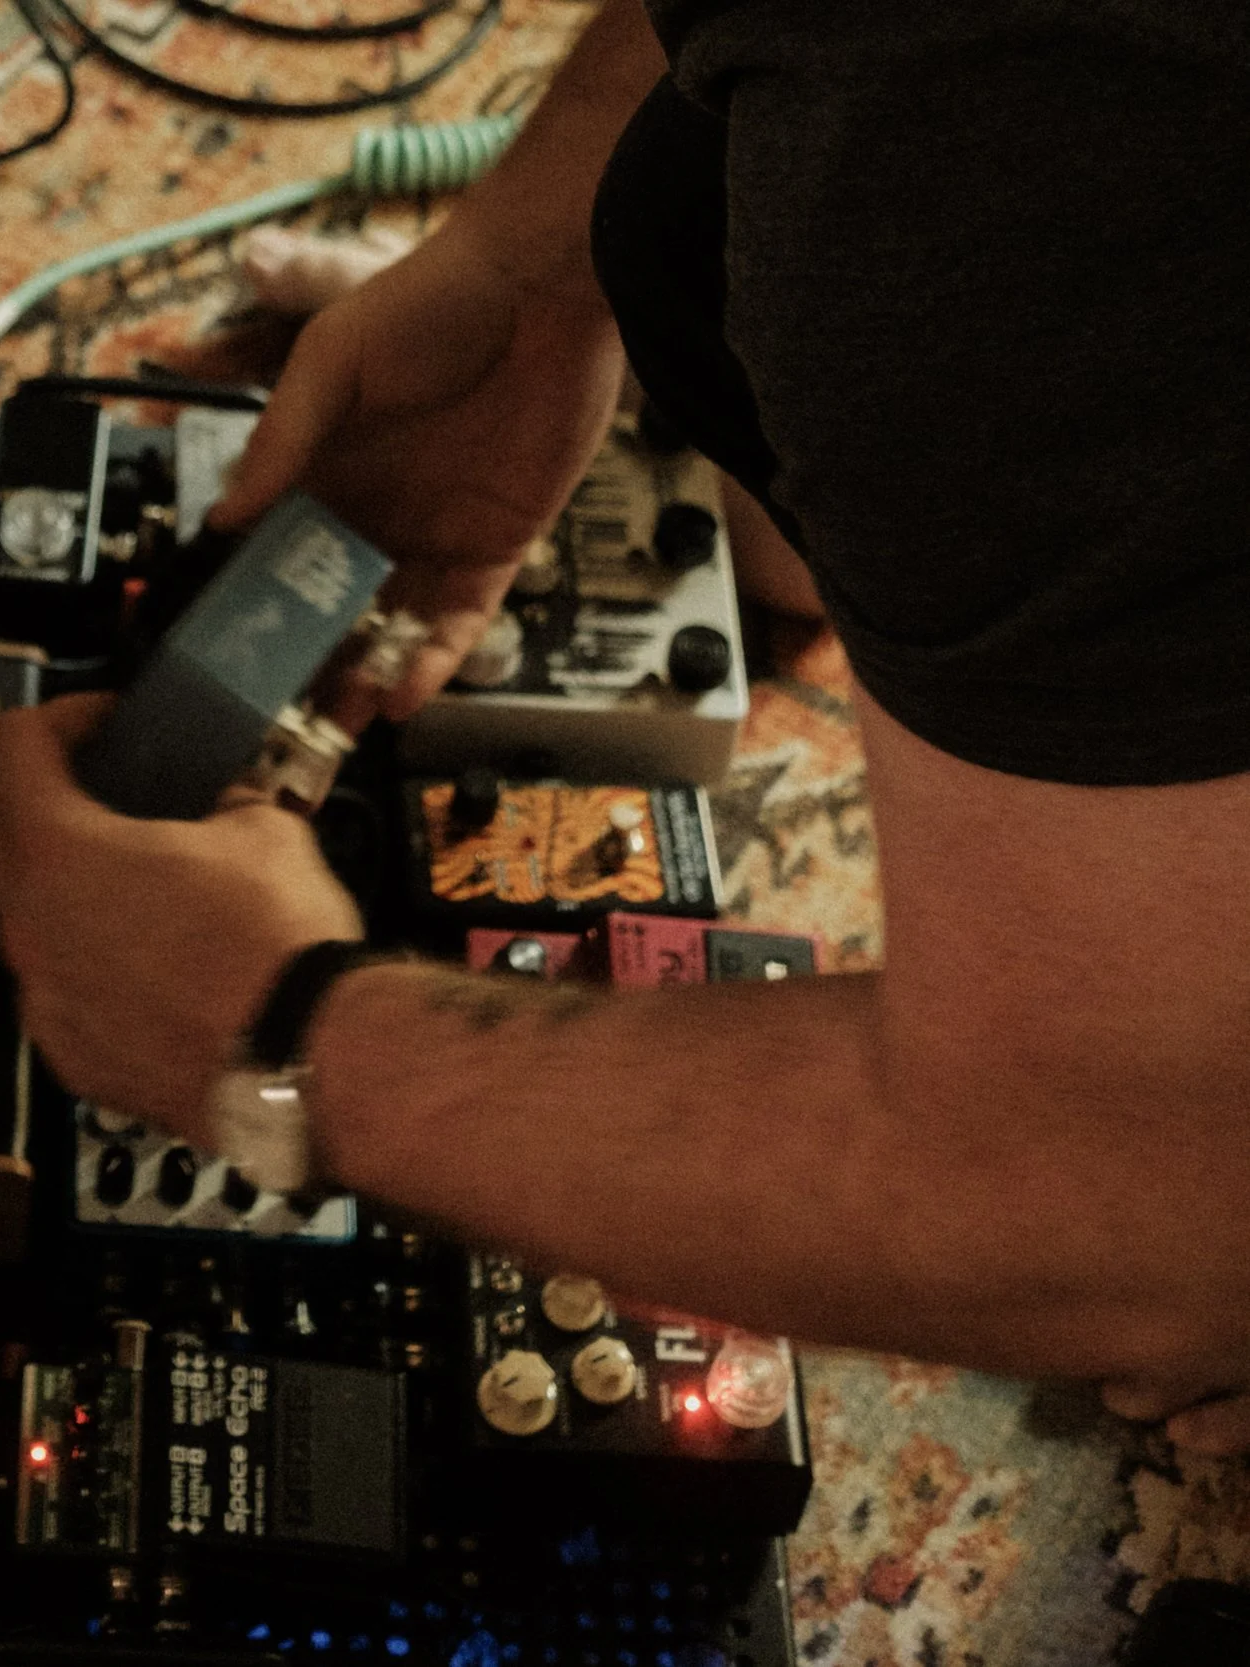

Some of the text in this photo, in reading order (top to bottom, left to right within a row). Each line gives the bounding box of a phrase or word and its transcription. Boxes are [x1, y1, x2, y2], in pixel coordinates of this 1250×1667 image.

[170, 1463, 186, 1514] OUTPUT
[188, 1465, 203, 1516] OUTPUT
[224, 1445, 251, 1534] Space
